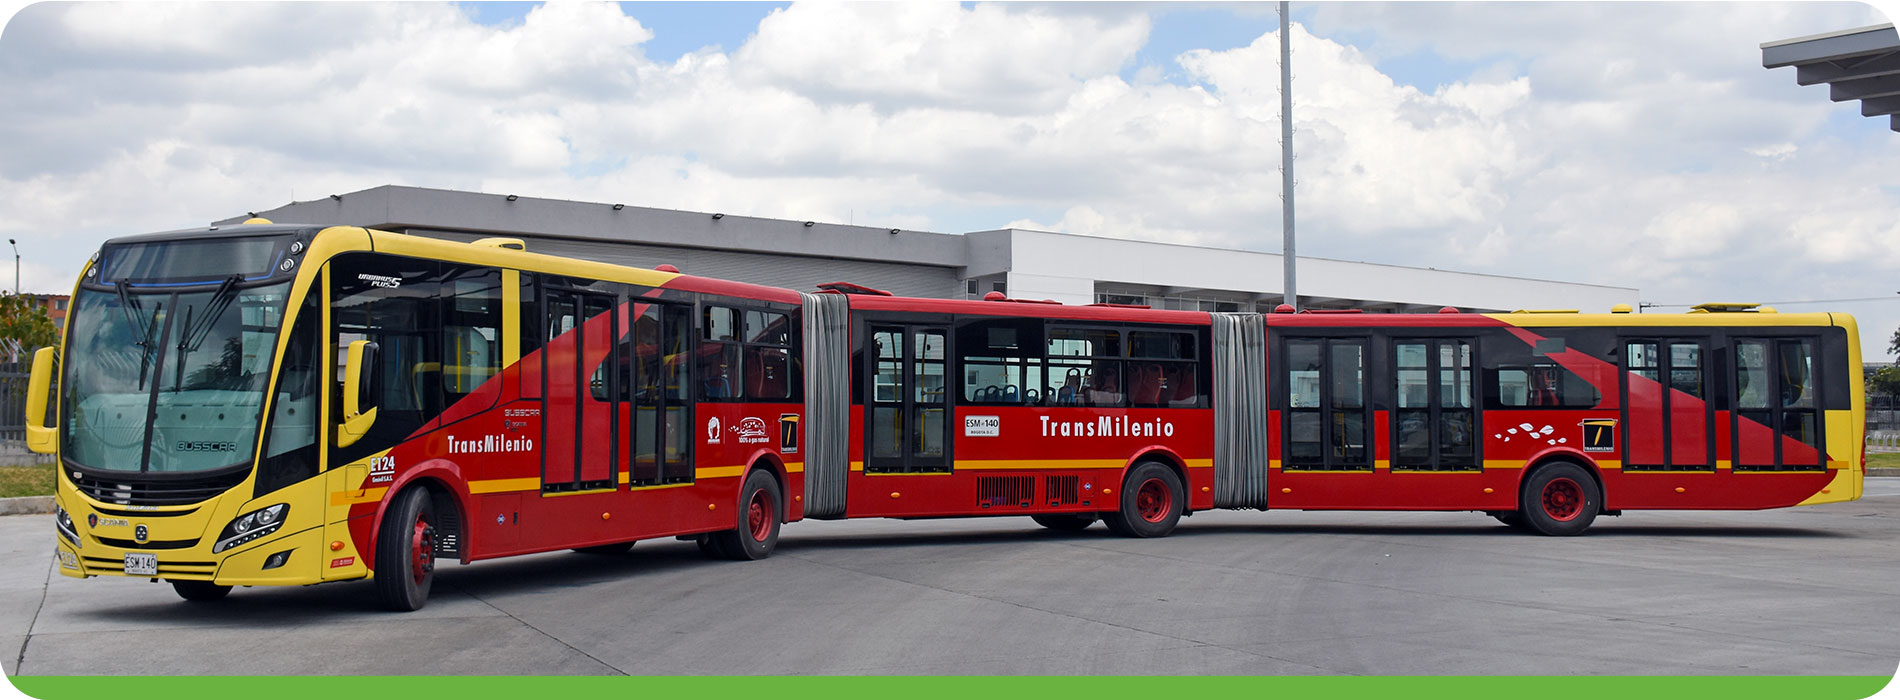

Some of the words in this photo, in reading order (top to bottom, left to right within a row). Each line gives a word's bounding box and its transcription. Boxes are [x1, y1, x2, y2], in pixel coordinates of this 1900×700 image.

[1040, 415, 1174, 437] TransMilenio
[176, 440, 238, 452] BUSSCAR
[447, 433, 533, 454] TransMilenio
[370, 455, 396, 471] E124
[125, 556, 140, 569] ESM
[142, 557, 156, 569] 140
